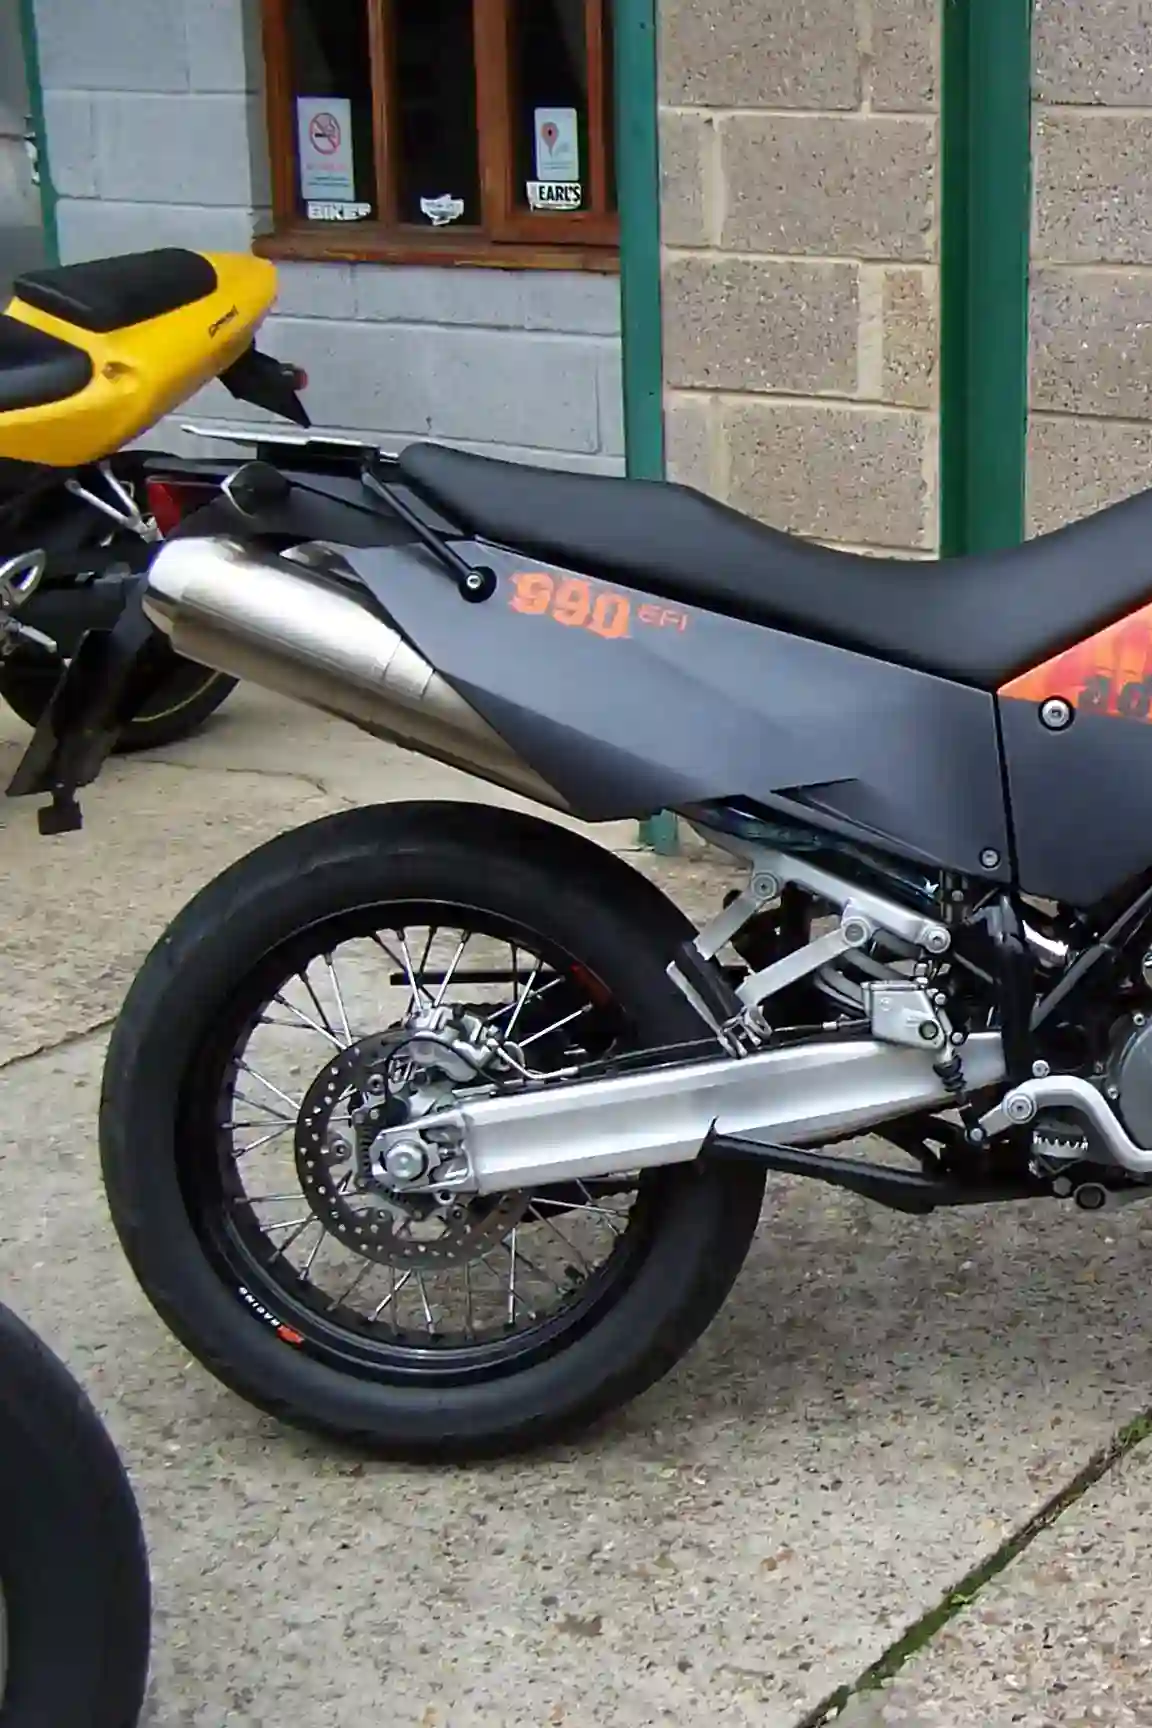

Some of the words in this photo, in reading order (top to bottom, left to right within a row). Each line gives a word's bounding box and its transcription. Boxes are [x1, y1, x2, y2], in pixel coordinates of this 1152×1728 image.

[539, 185, 581, 202] EARL'S
[508, 571, 633, 639] 990
[637, 603, 690, 633] EFI
